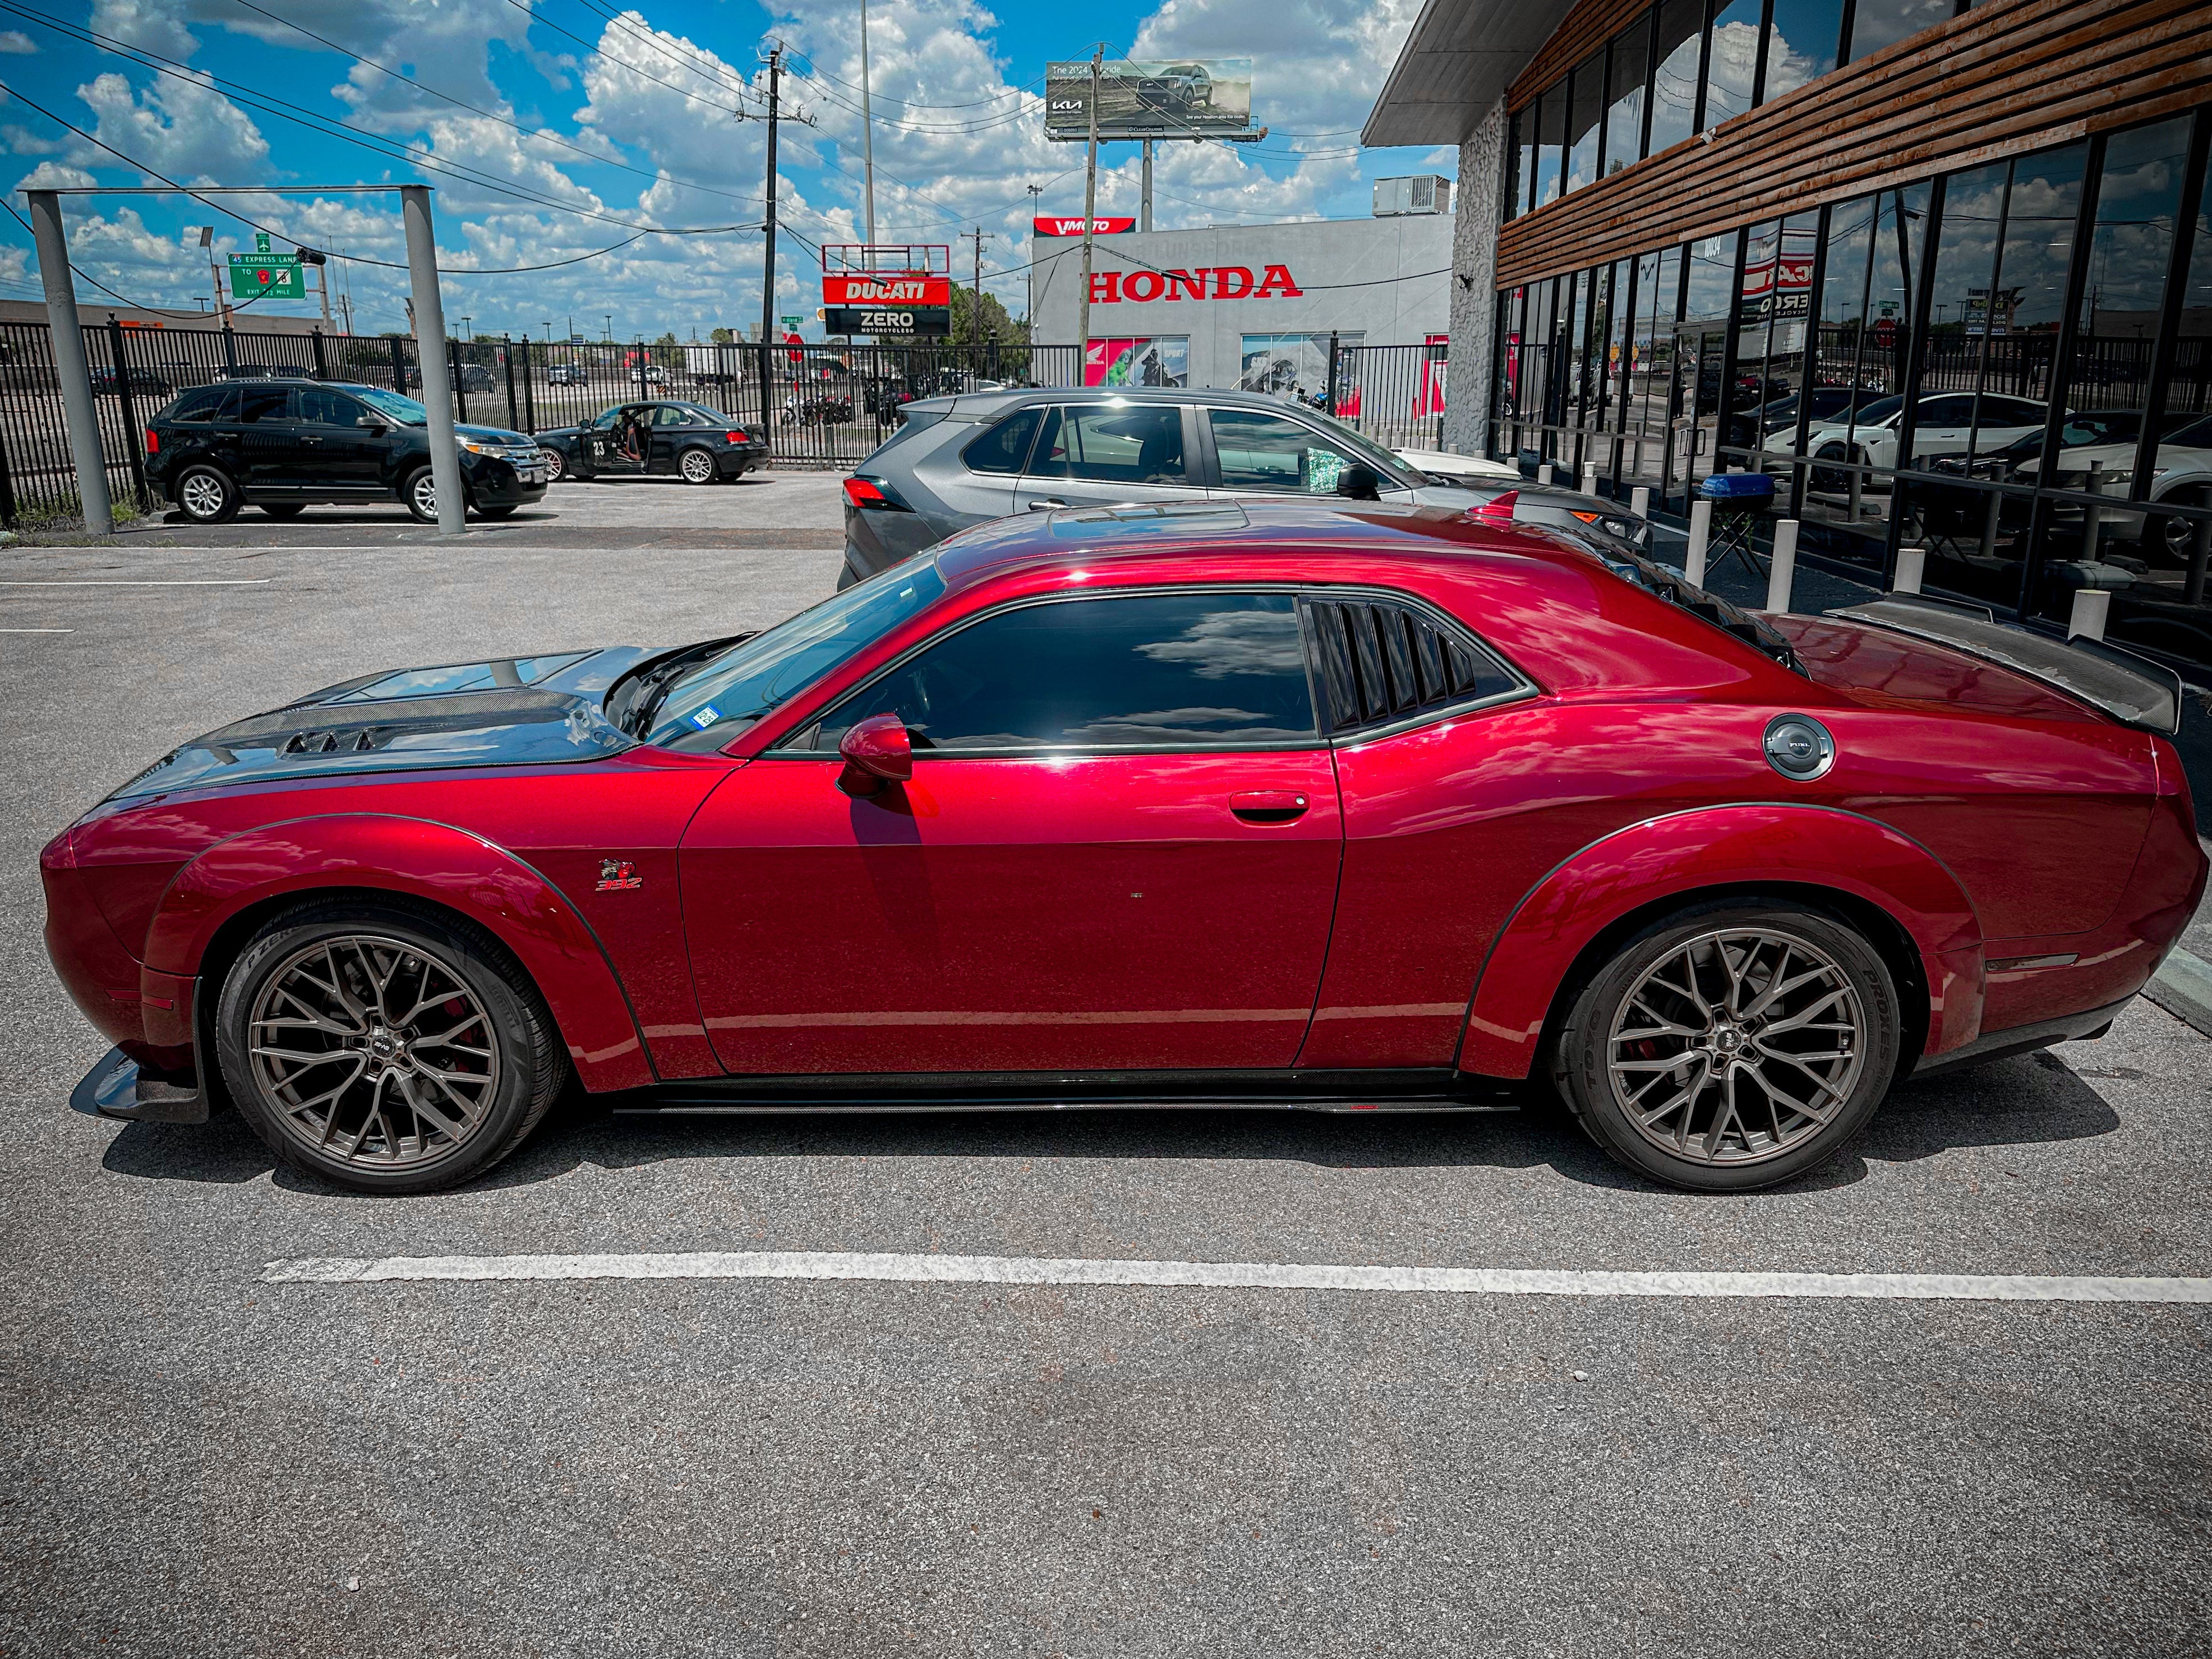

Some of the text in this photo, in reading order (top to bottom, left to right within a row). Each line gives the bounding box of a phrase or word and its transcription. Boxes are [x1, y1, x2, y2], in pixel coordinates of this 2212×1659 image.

[846, 282, 925, 299] DUCATI
[1079, 264, 1304, 304] HONDA
[861, 312, 914, 327] ZERO
[1164, 348, 1185, 358] SPORT
[593, 441, 605, 456] 23
[595, 877, 642, 891] 392
